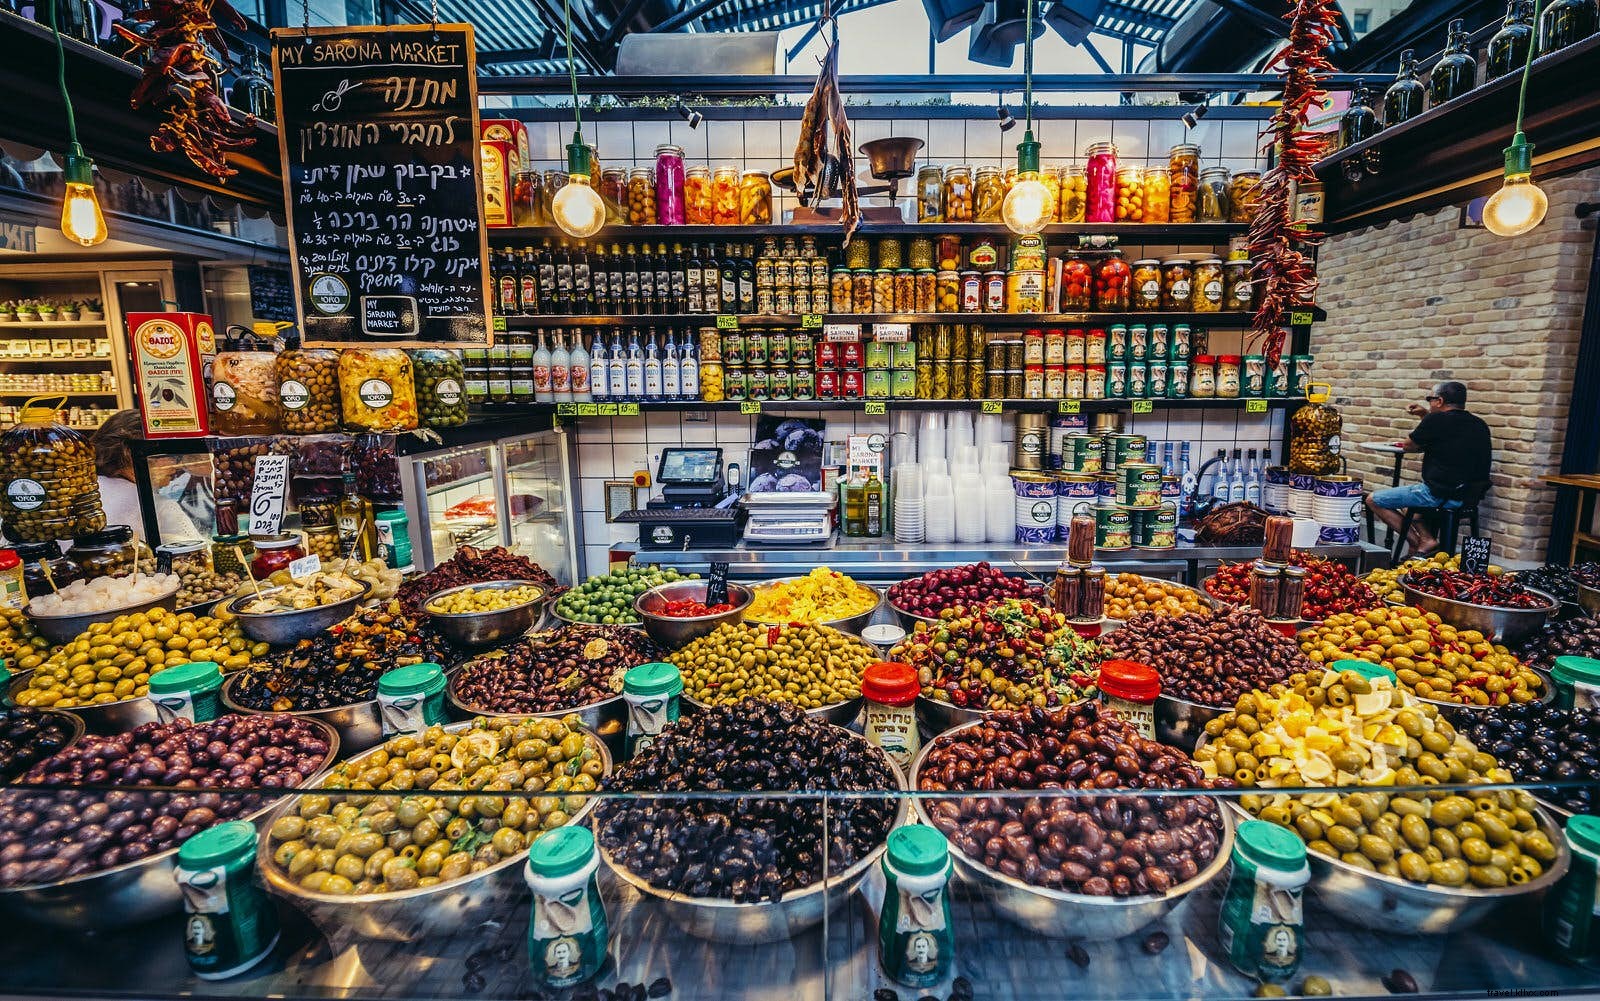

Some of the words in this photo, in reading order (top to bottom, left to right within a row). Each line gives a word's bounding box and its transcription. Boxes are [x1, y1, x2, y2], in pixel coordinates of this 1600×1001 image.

[281, 45, 304, 64] MY
[313, 43, 382, 62] SARONA
[390, 42, 459, 63] MARKET
[385, 76, 457, 111] מתנה
[390, 115, 459, 146] לחברי
[301, 121, 380, 162] המועדון
[346, 165, 386, 192] שמן
[393, 164, 458, 190] בקבוק
[328, 212, 380, 230] ברכה
[386, 213, 412, 230] הר
[431, 236, 460, 252] זוג
[355, 255, 397, 272] זיתים
[404, 254, 436, 278] קילו
[444, 257, 470, 278] קנו
[367, 300, 377, 309] MY
[367, 310, 397, 318] SARONA
[367, 319, 400, 328] MARKET
